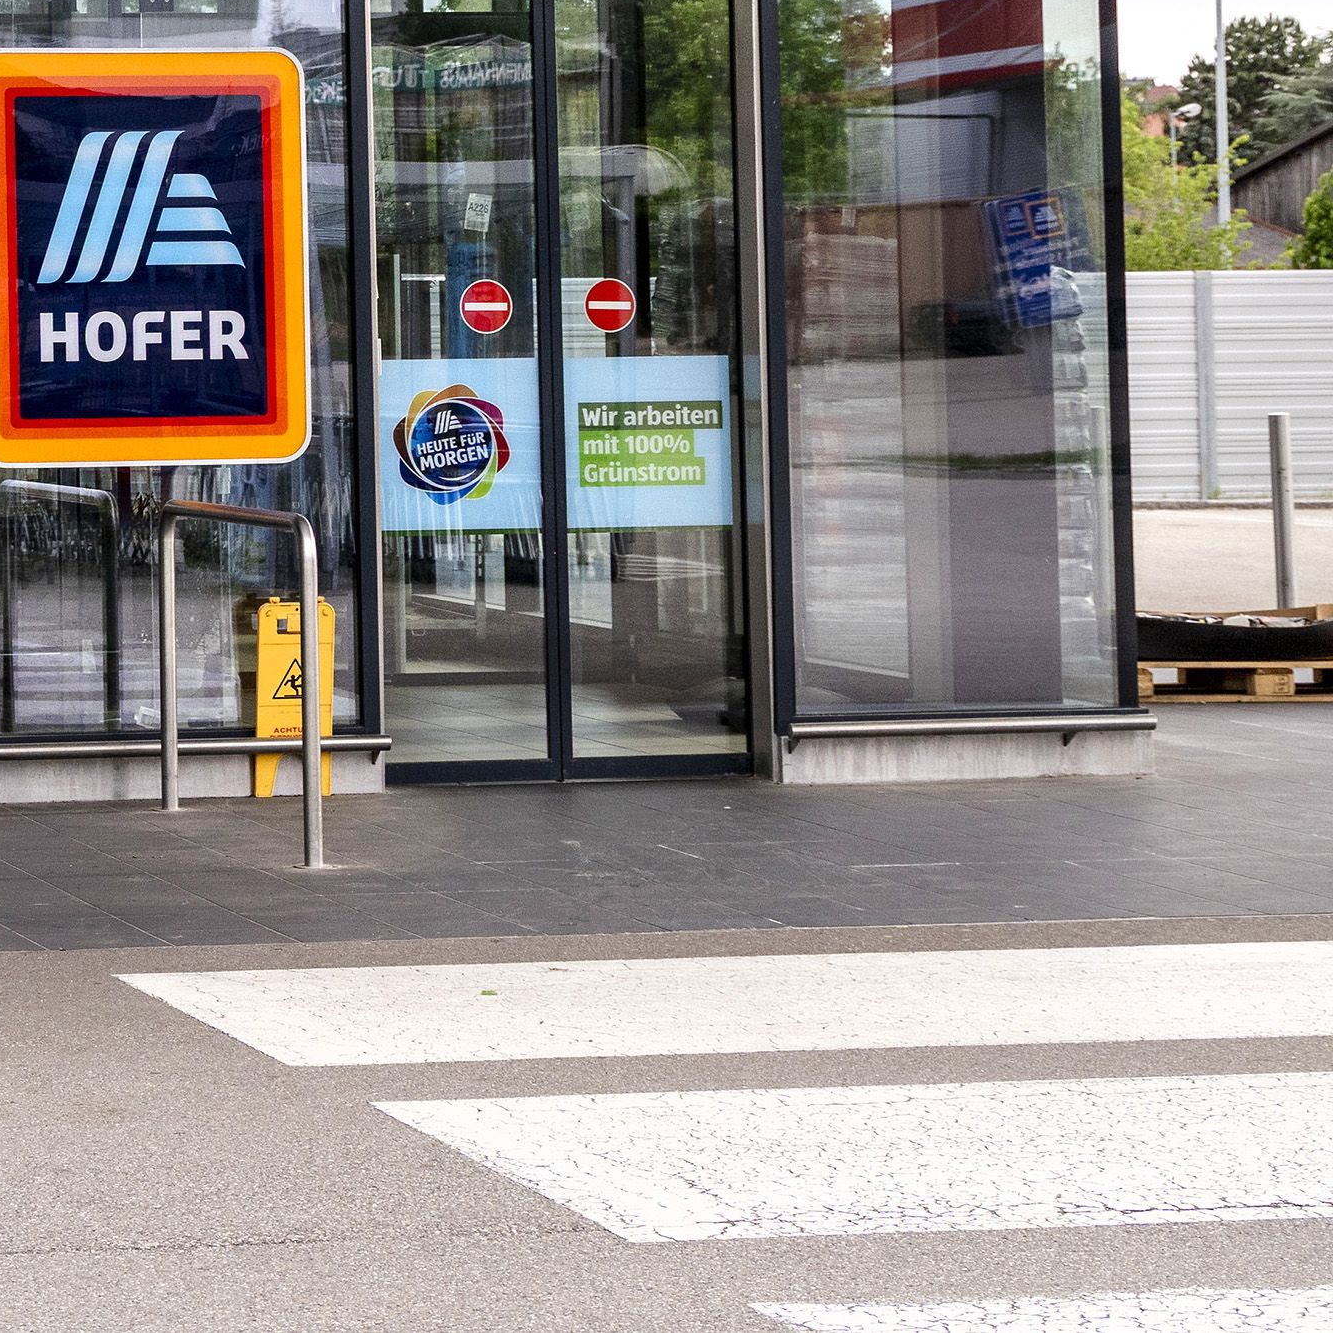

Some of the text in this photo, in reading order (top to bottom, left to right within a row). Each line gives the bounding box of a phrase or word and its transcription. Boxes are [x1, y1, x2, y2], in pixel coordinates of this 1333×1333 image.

[467, 202, 489, 214] A226
[39, 310, 249, 363] HOFER
[582, 404, 719, 427] Wir arbeiten
[416, 431, 486, 456] HEUTE FÜR
[583, 434, 691, 455] mit 100%
[419, 444, 489, 472] MORGEN
[583, 463, 702, 484] Grünstrom
